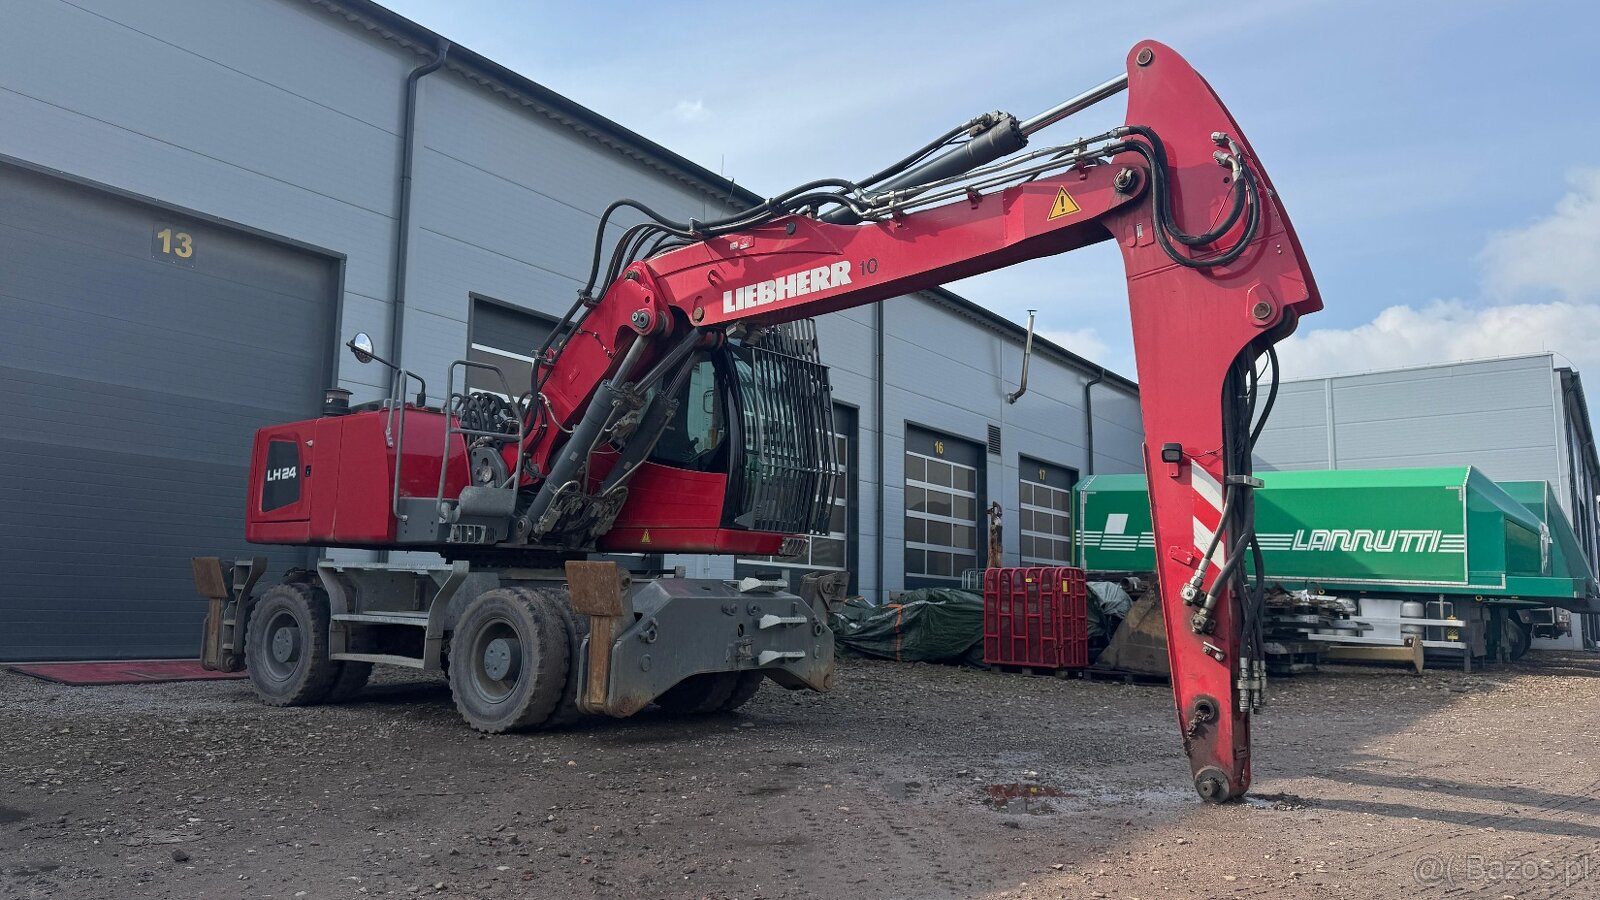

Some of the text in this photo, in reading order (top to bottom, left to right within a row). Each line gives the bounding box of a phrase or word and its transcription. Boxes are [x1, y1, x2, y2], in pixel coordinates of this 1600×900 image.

[157, 228, 193, 258] 13
[860, 258, 878, 276] 10
[723, 261, 852, 314] LIEBHERR
[934, 440, 944, 455] 16
[267, 466, 297, 481] LH24
[1038, 469, 1046, 480] 17
[1292, 529, 1442, 552] LANNUTTI
